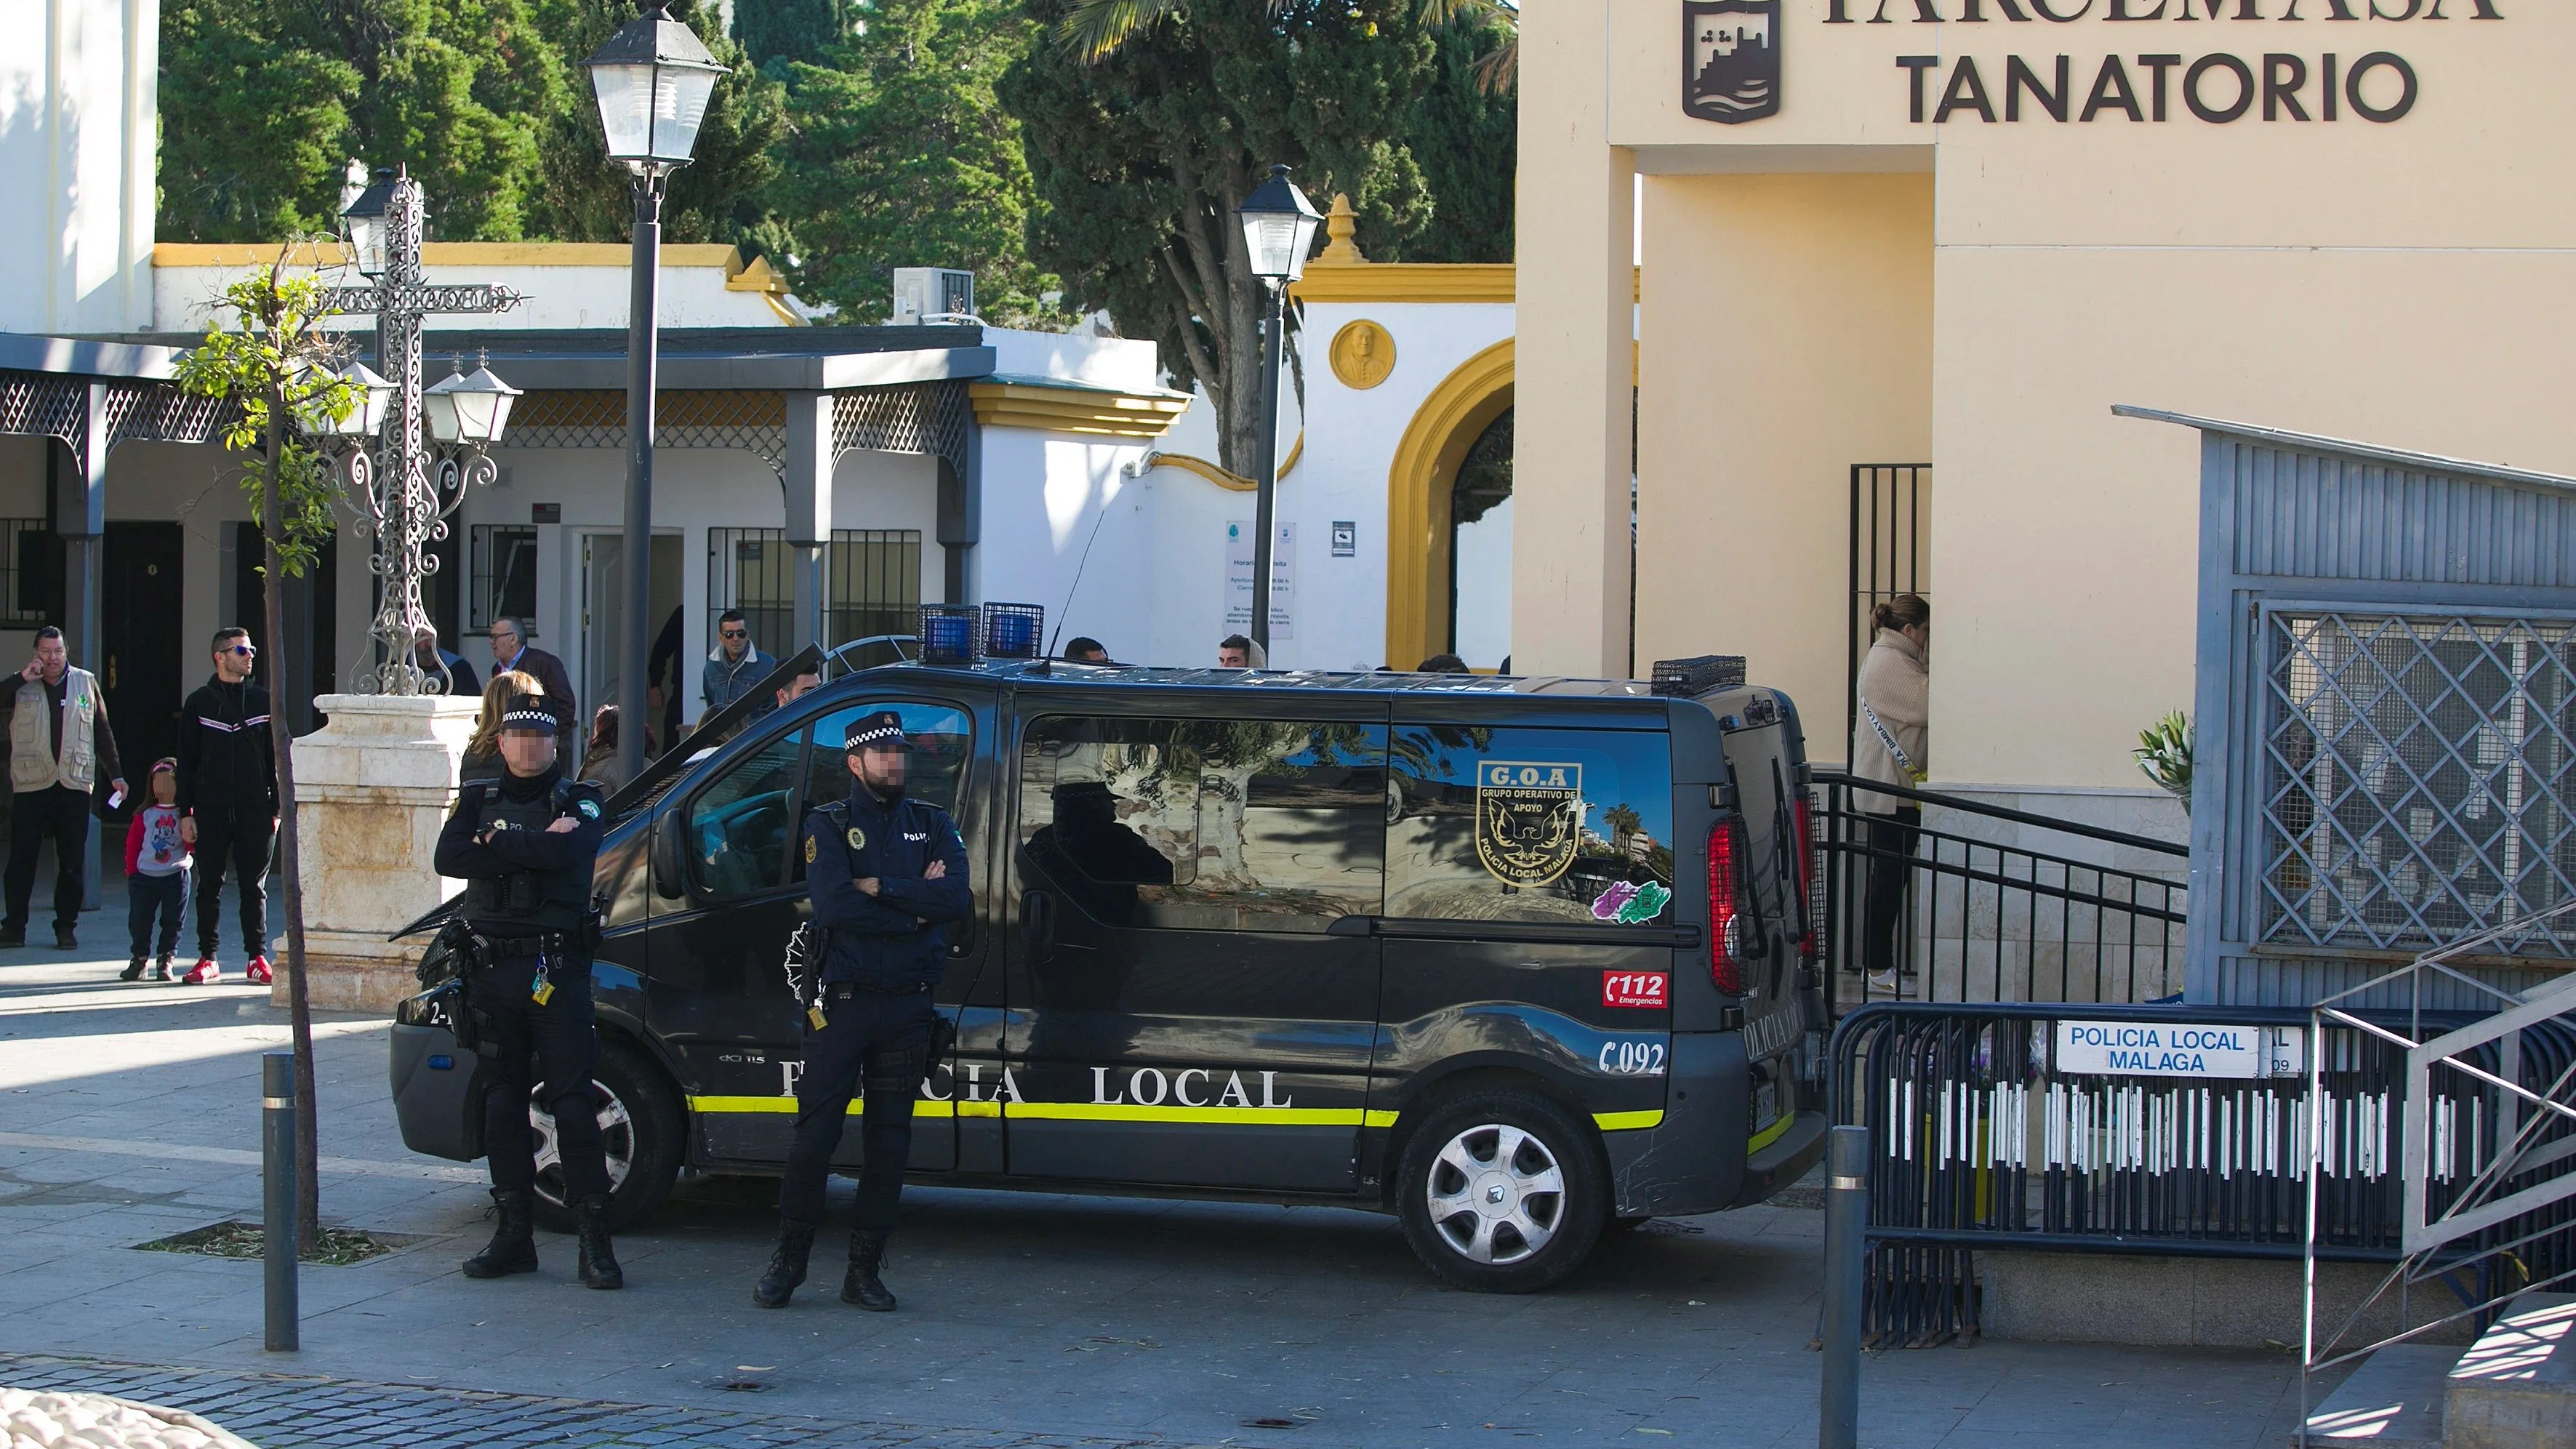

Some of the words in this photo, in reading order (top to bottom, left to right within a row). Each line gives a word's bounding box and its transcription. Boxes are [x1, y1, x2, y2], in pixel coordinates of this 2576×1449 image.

[1895, 51, 2418, 124] TANATORIO
[1490, 766, 1567, 787] G.O.A
[1482, 789, 1512, 798] GRUPO
[1514, 790, 1562, 799] OPERATIVO
[1564, 791, 1576, 800] DE
[1514, 803, 1543, 813] APOYO
[1480, 838, 1508, 872] POLICIA
[1509, 867, 1544, 878] LOCAL
[1544, 838, 1573, 874] MALAGA
[1619, 975, 1664, 995] 112
[1619, 996, 1663, 1006] Emergencias
[2071, 1027, 2160, 1048] POLICIA
[2171, 1030, 2245, 1051] LOCAL
[746, 1056, 766, 1064] 115
[1619, 1042, 1664, 1075] 092
[2109, 1051, 2205, 1072] MALAGA
[778, 1061, 1026, 1104] PCIA
[1090, 1067, 1292, 1108] LOCAL
